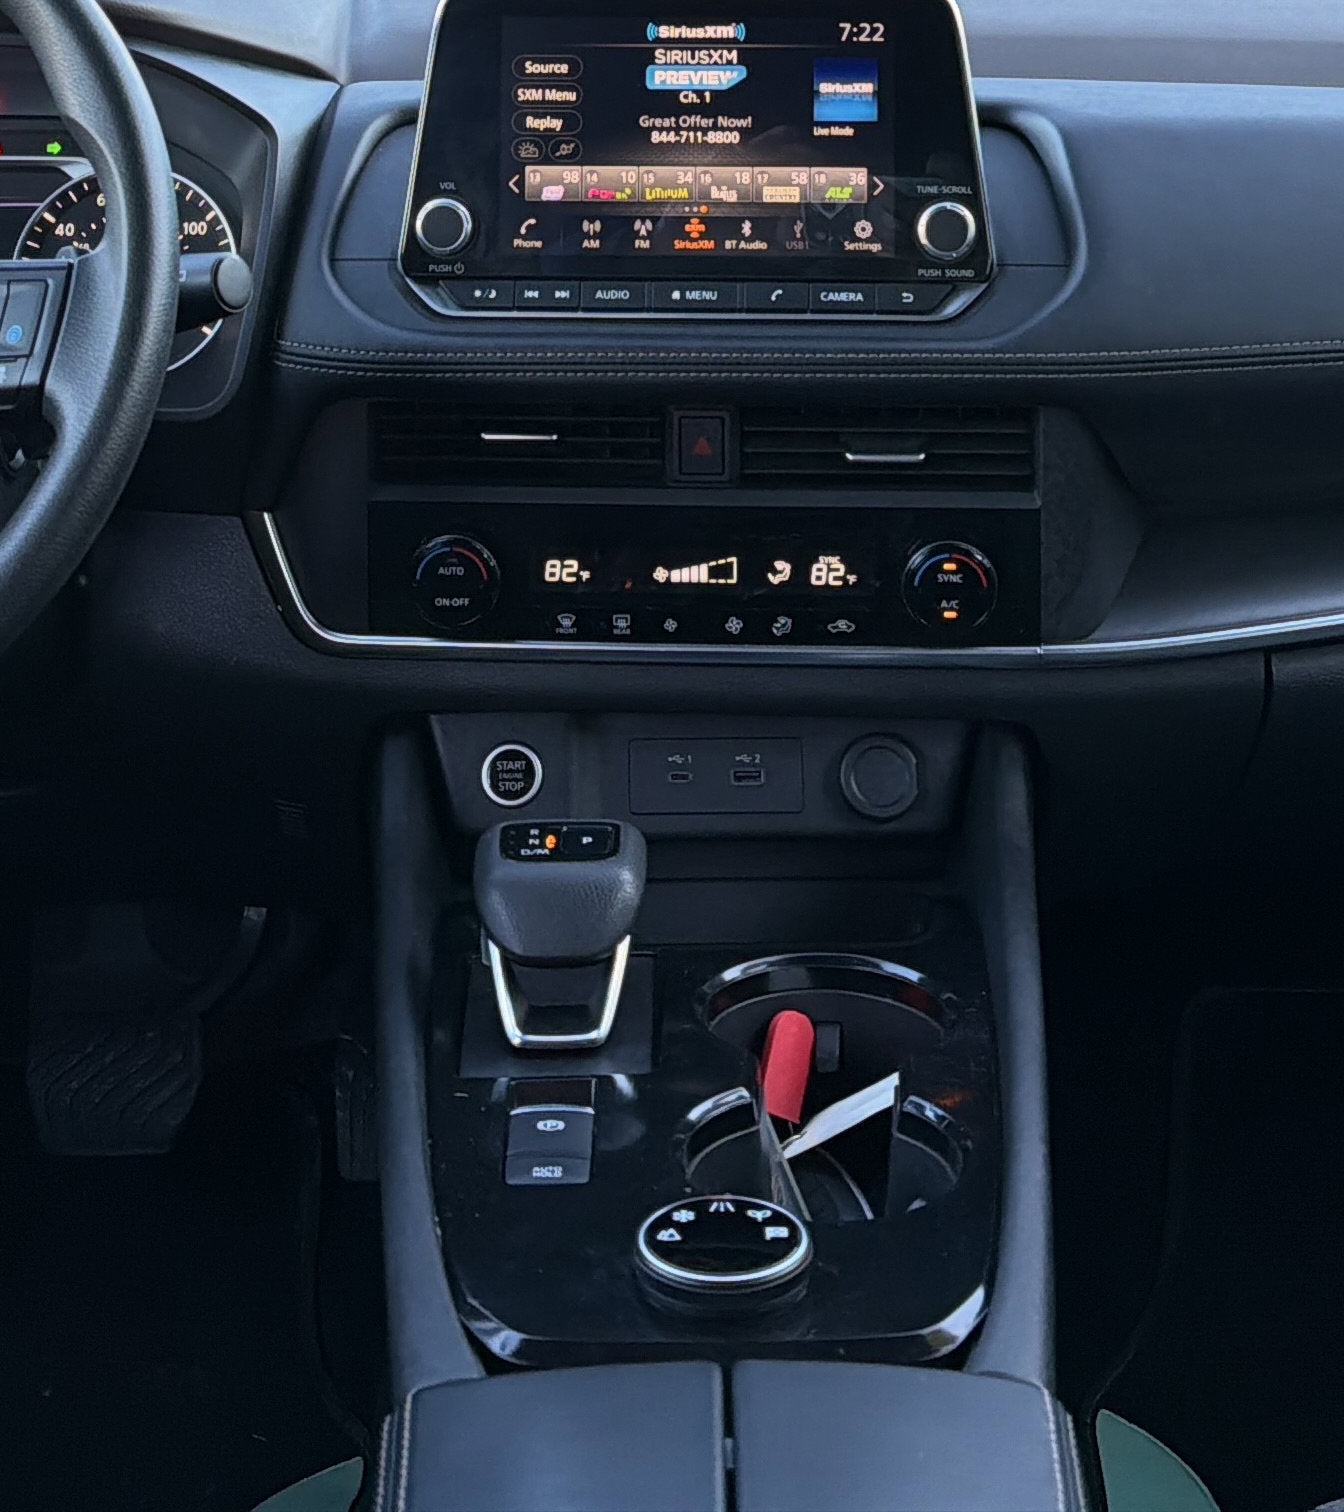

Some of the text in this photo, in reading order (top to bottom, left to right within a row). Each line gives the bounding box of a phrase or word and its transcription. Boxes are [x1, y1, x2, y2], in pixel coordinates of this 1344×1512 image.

[839, 23, 885, 42] 7:22
[654, 49, 738, 64] SIRIUSXM
[524, 61, 568, 73] Source
[654, 70, 739, 85] PREVIEW
[517, 88, 577, 101] SXM Menu
[679, 91, 711, 103] Ch. 1
[526, 116, 563, 131] Replay
[639, 115, 752, 128] Great Offer Now!
[813, 126, 854, 136] Live Mode
[650, 131, 741, 144] 844-711-8800
[562, 171, 580, 184] 98
[620, 171, 636, 184] 10
[676, 171, 693, 184] 34
[699, 172, 712, 185] 16
[735, 172, 751, 185] 18
[791, 172, 808, 185] 58
[849, 172, 865, 185] 36
[55, 223, 75, 237] 40
[183, 221, 207, 236] 100
[513, 239, 542, 248] Phone
[582, 240, 600, 249] AM
[635, 240, 650, 249] FM
[674, 240, 715, 249] SiriusXM
[725, 240, 768, 250] BT Audio
[844, 241, 882, 252] Settings
[429, 264, 452, 273] PUSH
[917, 268, 975, 278] PUSH SOUND
[595, 290, 630, 300] AUDIO
[685, 290, 718, 300] MENU
[820, 292, 864, 302] CAMERA
[437, 566, 465, 576] AUTO
[936, 573, 964, 584] SYNC
[940, 599, 960, 609] A/C
[496, 760, 526, 771] START
[499, 781, 525, 792] STOP
[530, 828, 540, 836] R
[582, 836, 593, 844] P
[521, 848, 550, 856] D/M
